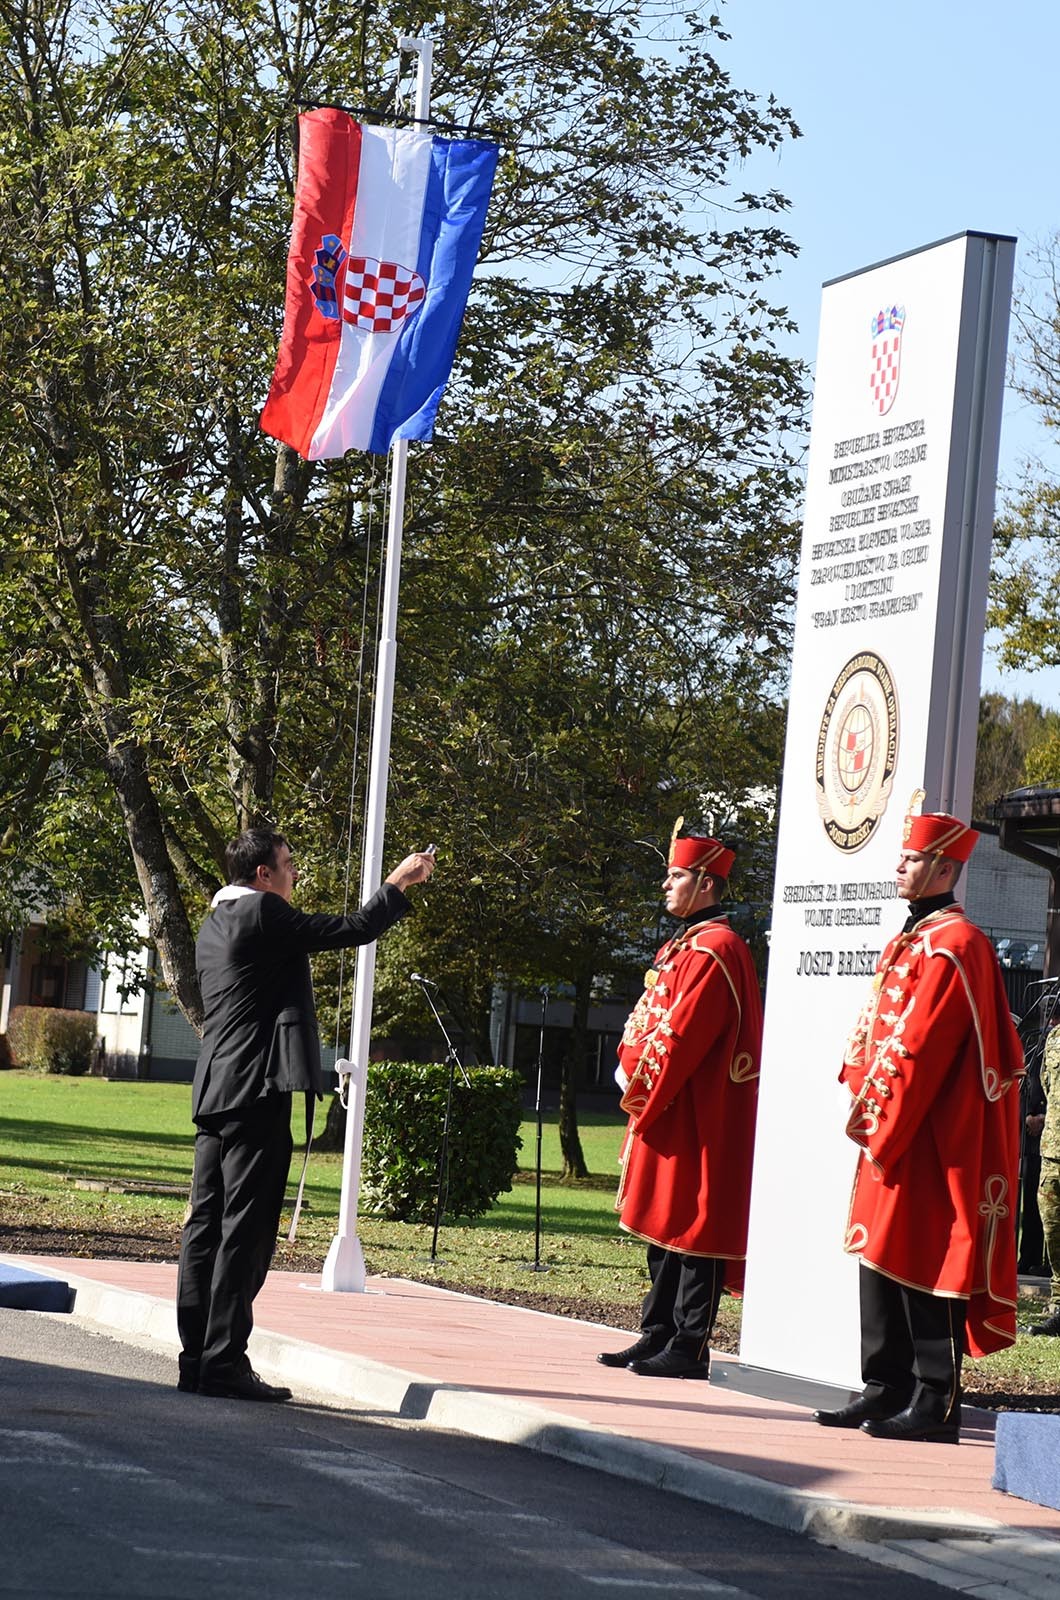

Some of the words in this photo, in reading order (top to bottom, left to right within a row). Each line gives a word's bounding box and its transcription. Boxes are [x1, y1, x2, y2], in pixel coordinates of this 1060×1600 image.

[829, 455, 891, 484] MINISTARSTVO
[893, 444, 928, 468] OBRANE
[887, 553, 899, 569] ZA
[825, 884, 838, 902] ZA
[804, 908, 834, 927] VOJNE
[834, 907, 882, 927] OPERACIJE
[797, 951, 834, 977] JOSIP
